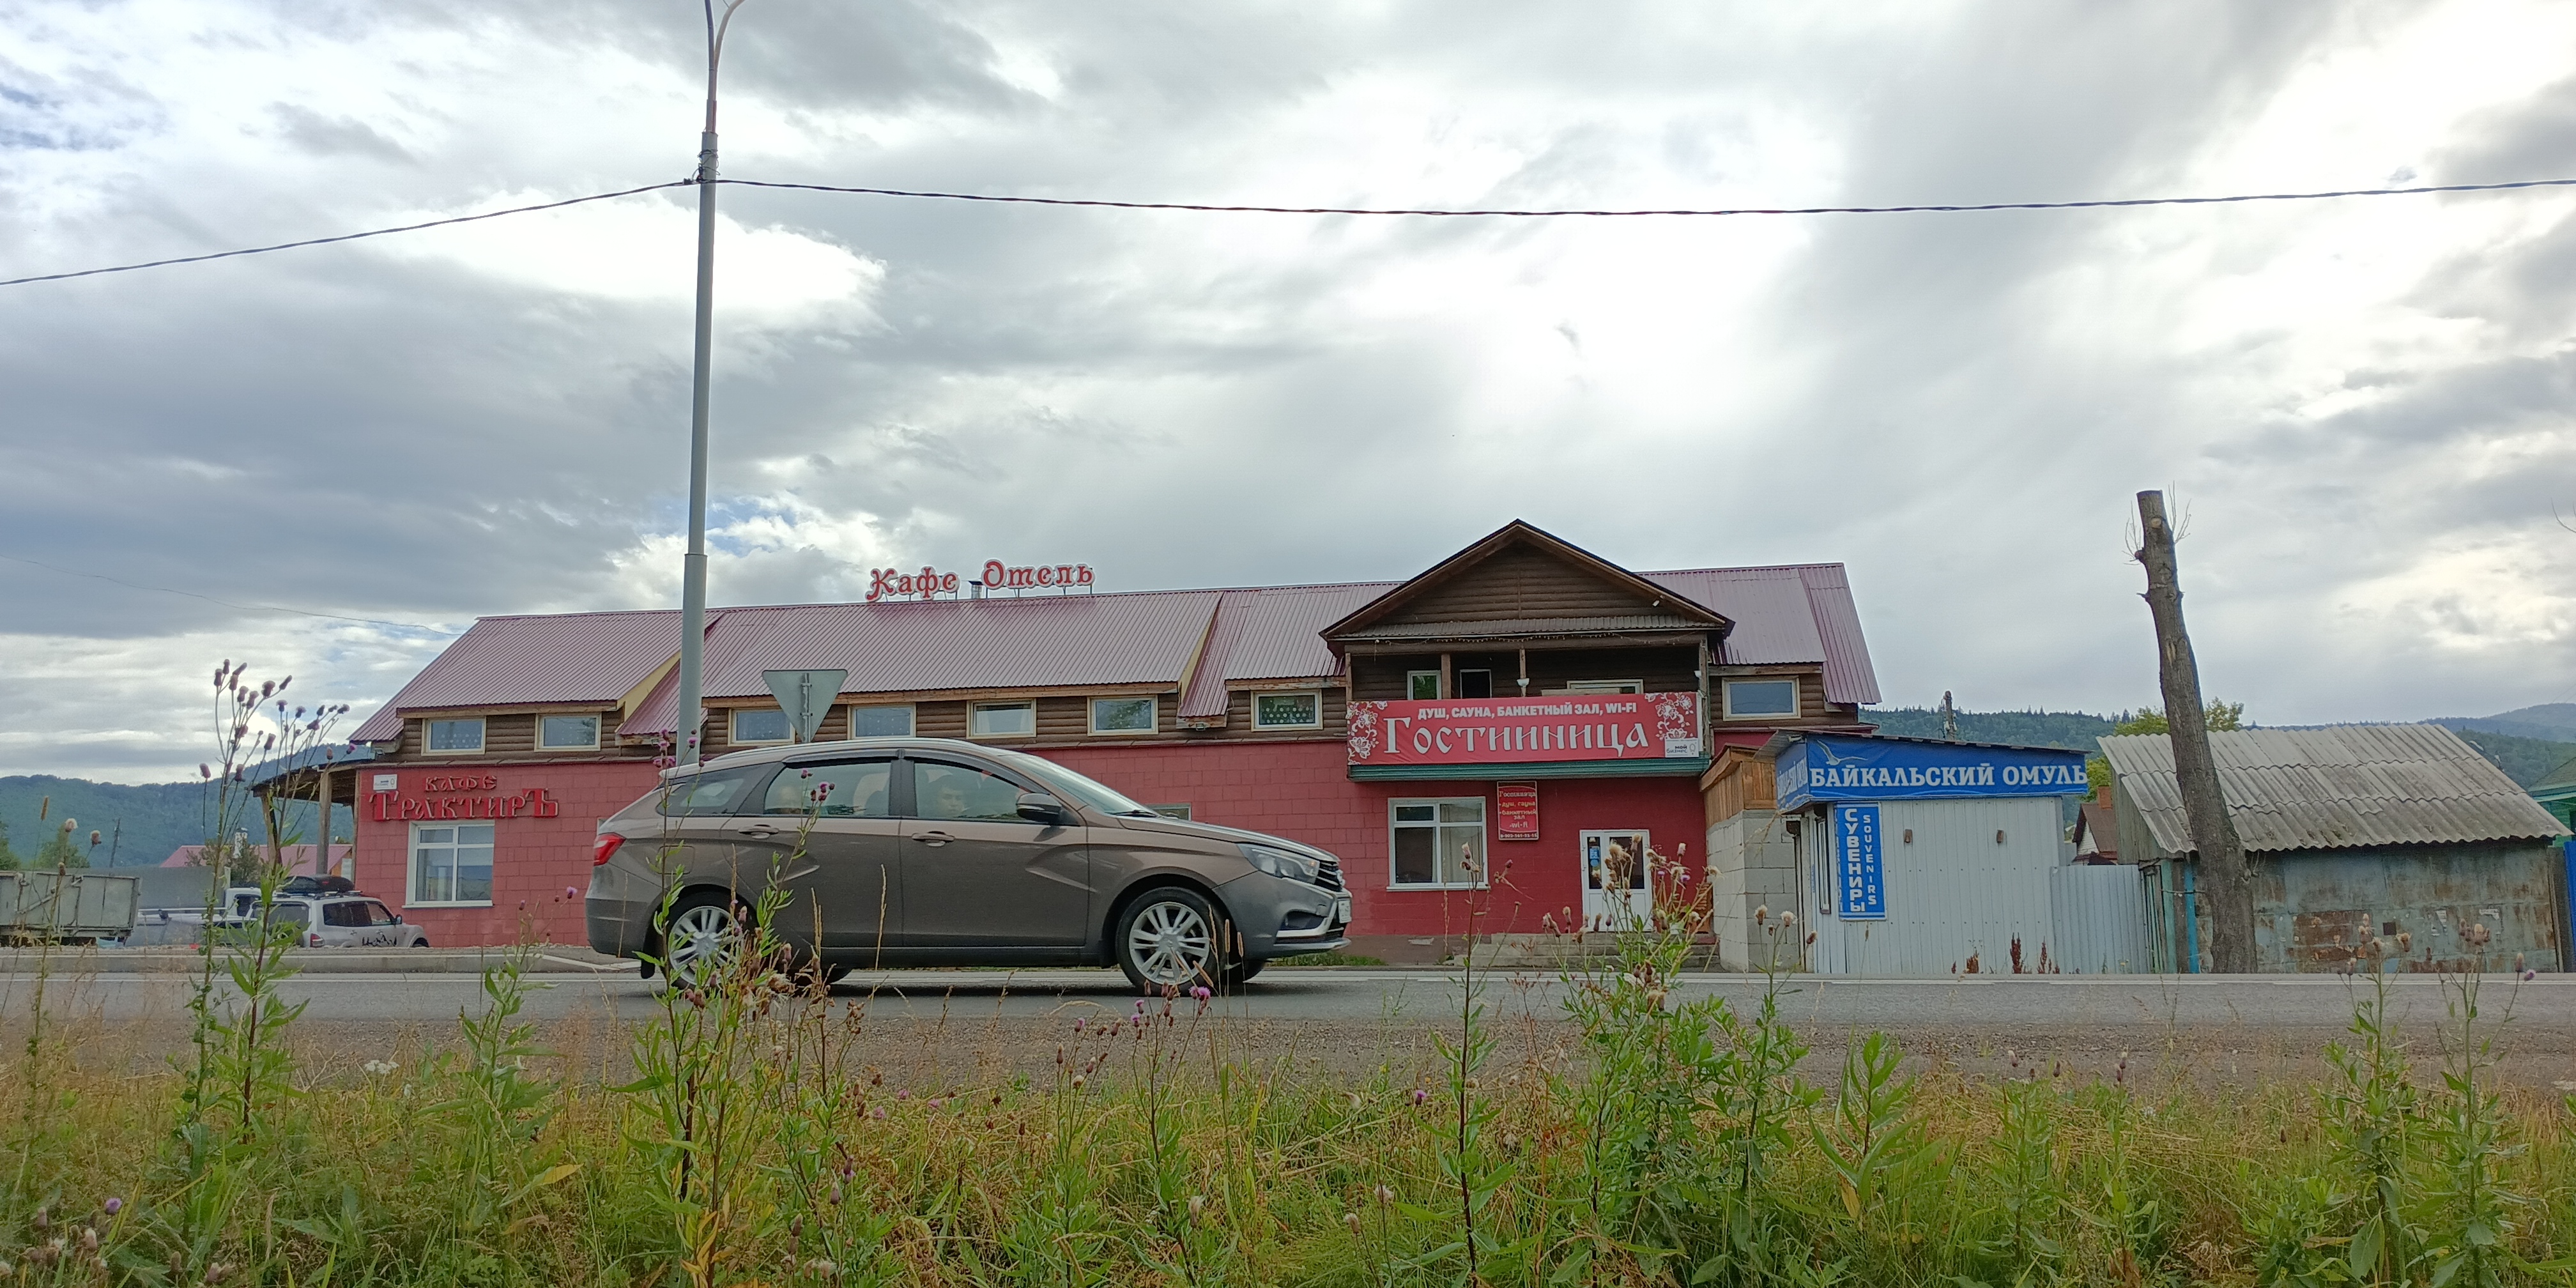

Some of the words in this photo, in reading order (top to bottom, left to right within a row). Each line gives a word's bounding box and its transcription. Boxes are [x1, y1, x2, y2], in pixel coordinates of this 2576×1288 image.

[866, 566, 958, 601] Кафе
[982, 560, 1093, 589] Отель
[1418, 708, 1450, 720] ДУШ,
[1452, 707, 1495, 719] САУНА,
[1497, 702, 1572, 717] БАНКЕТНЫЙ
[1574, 703, 1603, 716] ЗАЛ,
[1605, 702, 1637, 714] WI-FI
[425, 775, 497, 792] КАФЕ
[1809, 763, 1995, 787] БАЙКАЛЬСКИЙ
[2002, 765, 2088, 786] ОМУЛЬ
[1844, 808, 1865, 912] СУВЕНИРЫ
[1863, 815, 1876, 905] SOUVENIRS
